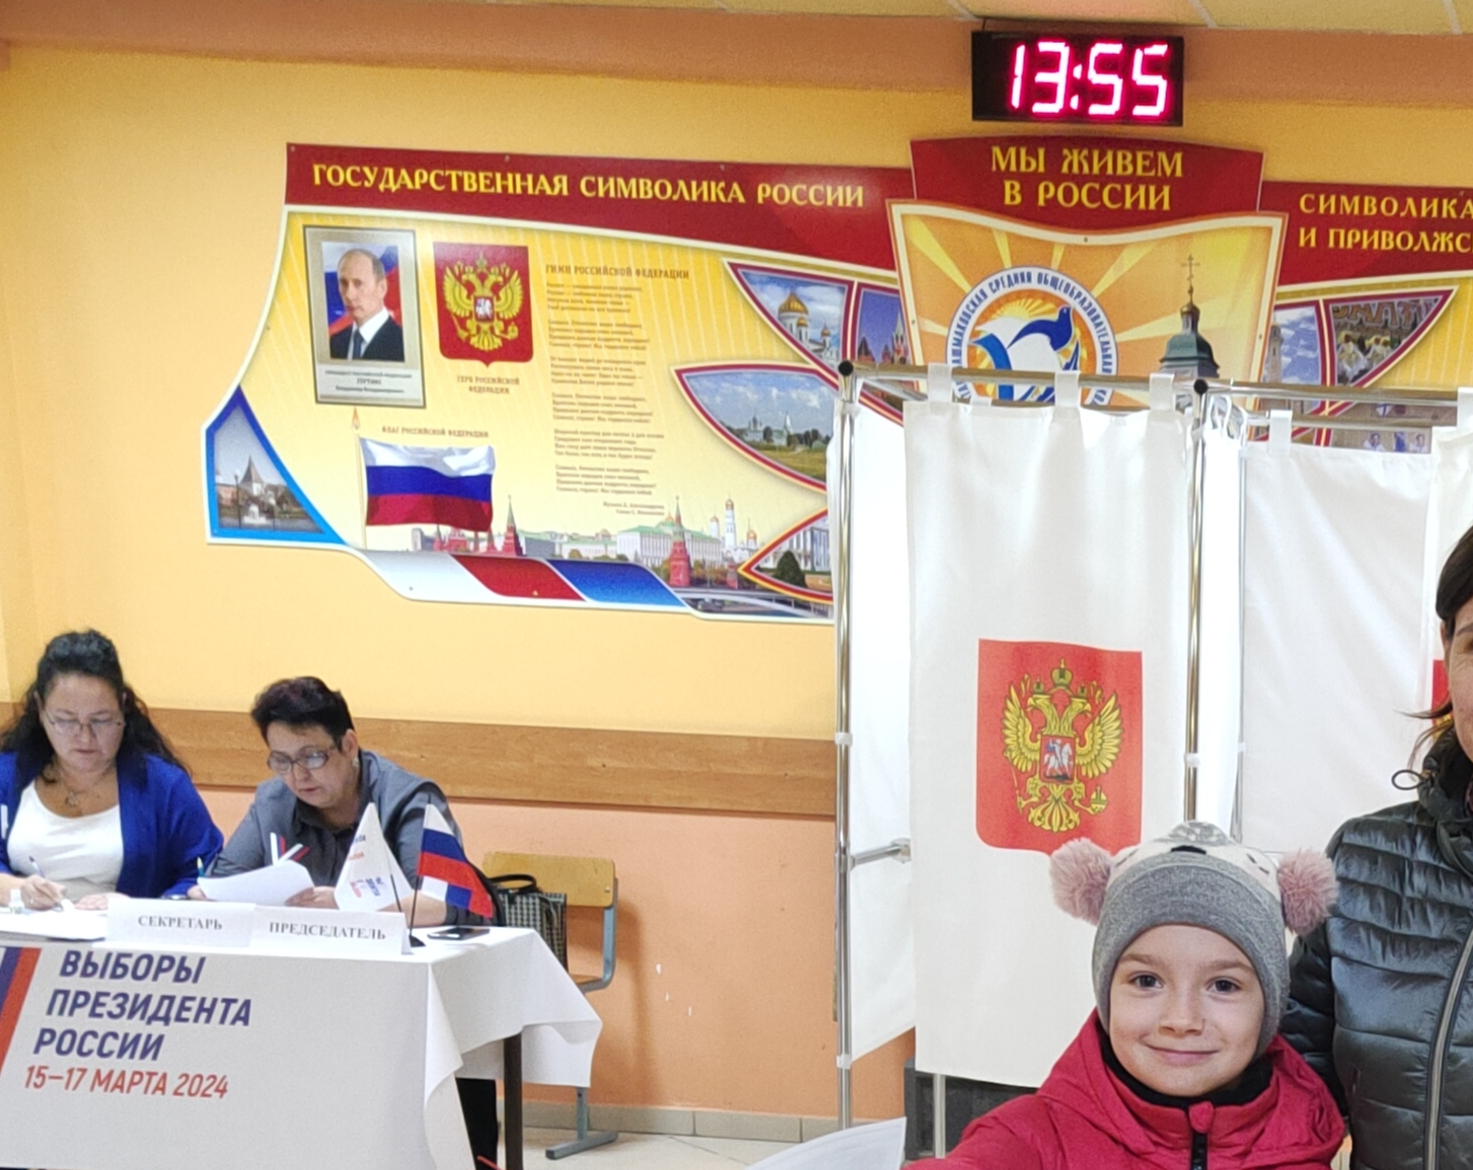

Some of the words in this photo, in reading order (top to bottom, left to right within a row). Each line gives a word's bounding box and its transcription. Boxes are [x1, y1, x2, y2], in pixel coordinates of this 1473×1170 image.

[1010, 41, 1169, 117] 13:55
[991, 146, 1046, 174] МЫ
[1061, 148, 1184, 178] ЖИВЕМ
[312, 164, 569, 196] ГОСУДАРСТВЕННАЯ
[579, 175, 746, 204] СИМВОЛИКА
[757, 183, 864, 208] РОССИИ
[1003, 179, 1023, 206] В
[1037, 181, 1171, 211] РОССИИ
[1299, 227, 1317, 249] И
[138, 915, 222, 931] СЕКРЕТАРЬ
[269, 922, 386, 940] ПРЕДСЕДАТЕЛЬ
[59, 949, 206, 984] ВЫБОРЫ
[46, 988, 252, 1027] ПРЕЗИДЕНТА
[33, 1027, 165, 1061] РОССИИ
[89, 1068, 168, 1096] МАРТА
[172, 1073, 229, 1099] 2024
